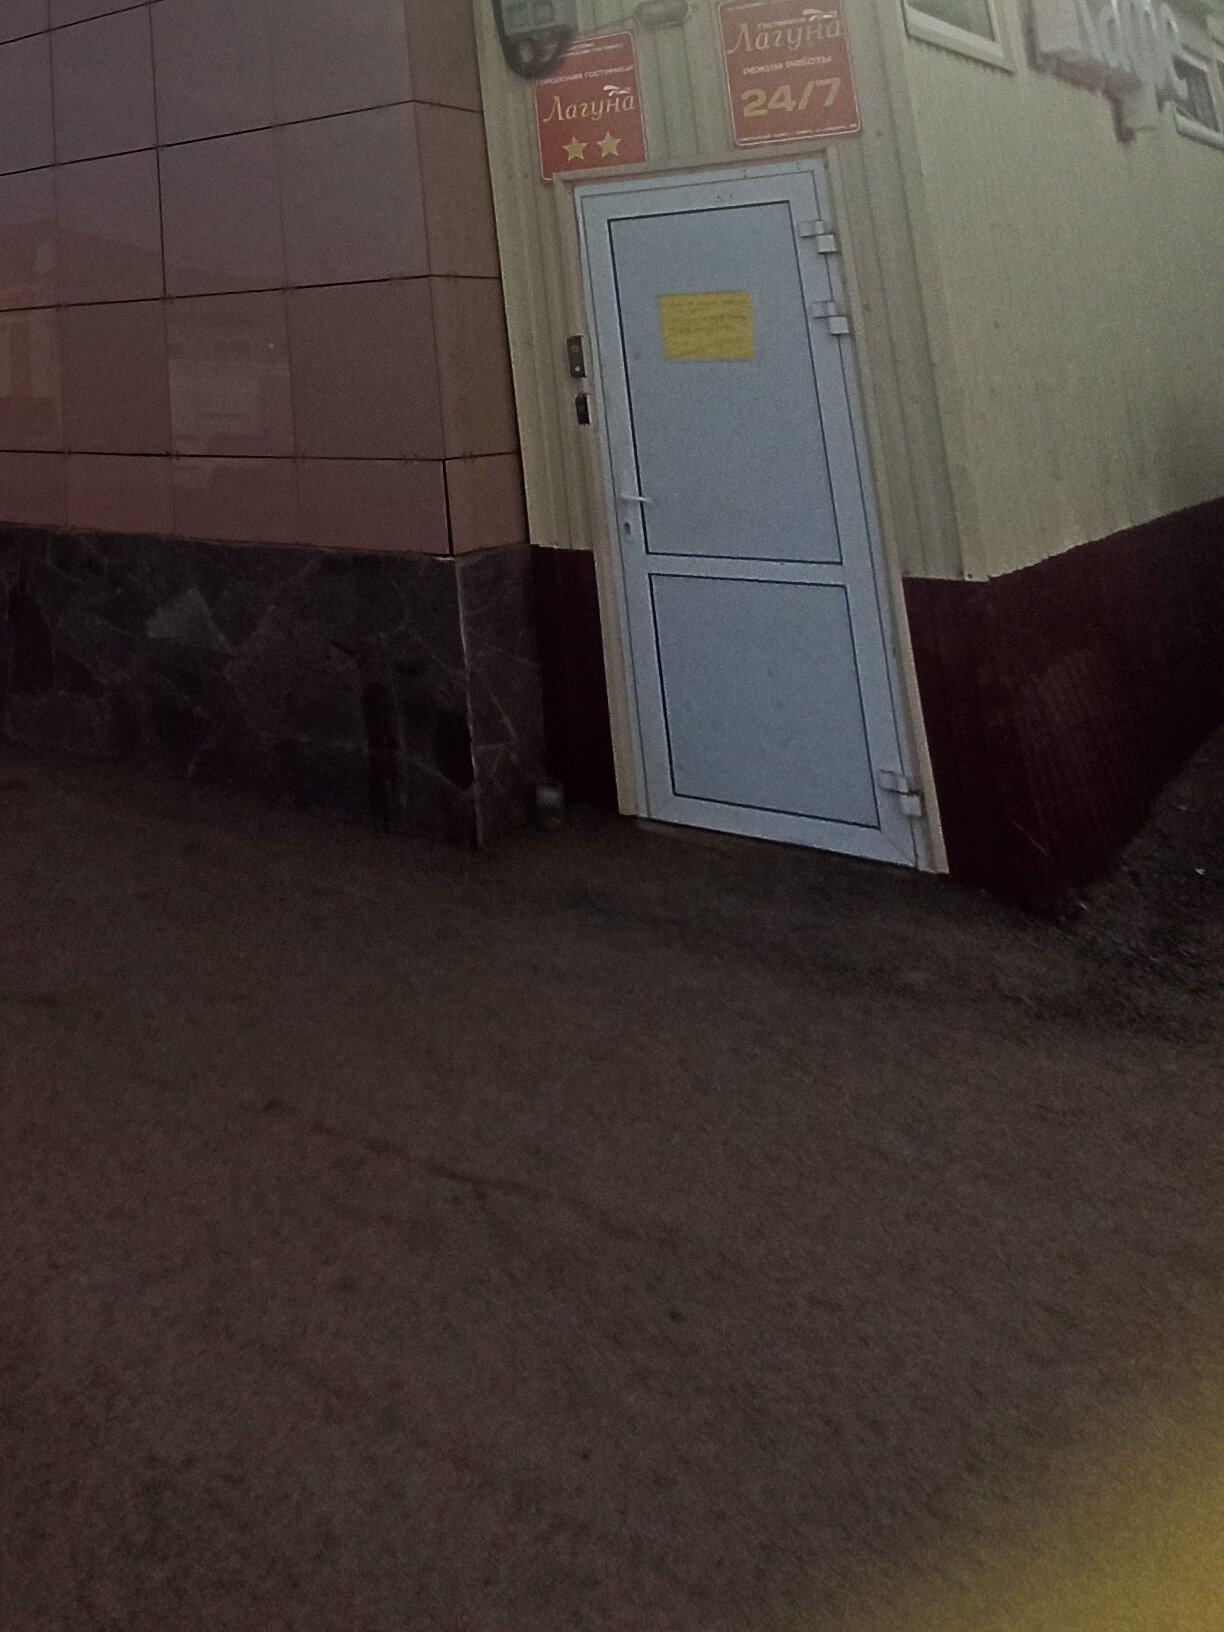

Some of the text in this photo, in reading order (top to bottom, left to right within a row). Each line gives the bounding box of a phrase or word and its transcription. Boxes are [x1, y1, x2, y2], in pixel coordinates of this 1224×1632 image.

[727, 19, 841, 55] Лагуна
[542, 95, 635, 123] Лагуна
[741, 77, 842, 118] 24/7
